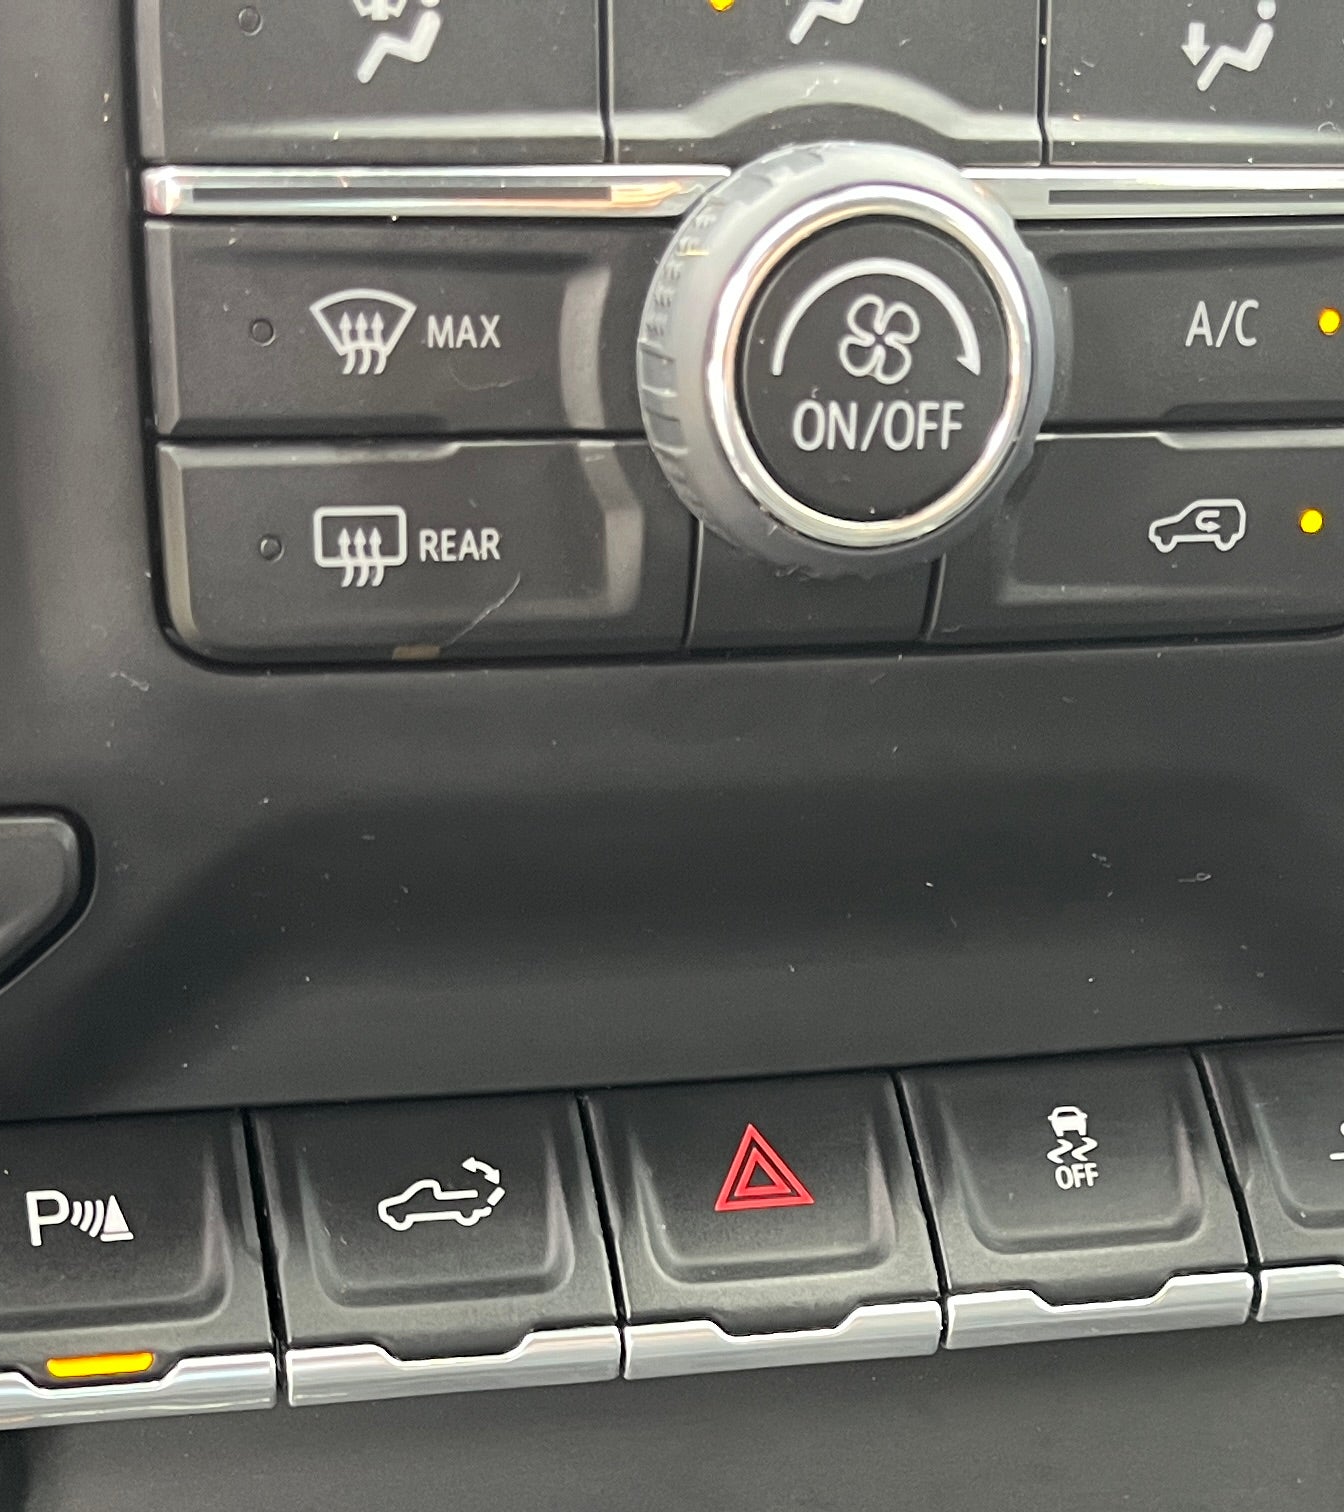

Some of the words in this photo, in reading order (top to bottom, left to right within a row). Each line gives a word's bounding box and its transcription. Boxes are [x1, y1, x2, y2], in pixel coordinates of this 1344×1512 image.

[425, 313, 502, 350] MAX
[1185, 300, 1260, 348] A/C
[791, 399, 964, 452] ON/OFF
[418, 528, 501, 563] REAR
[1054, 1163, 1099, 1190] OFF
[25, 1189, 70, 1246] P
